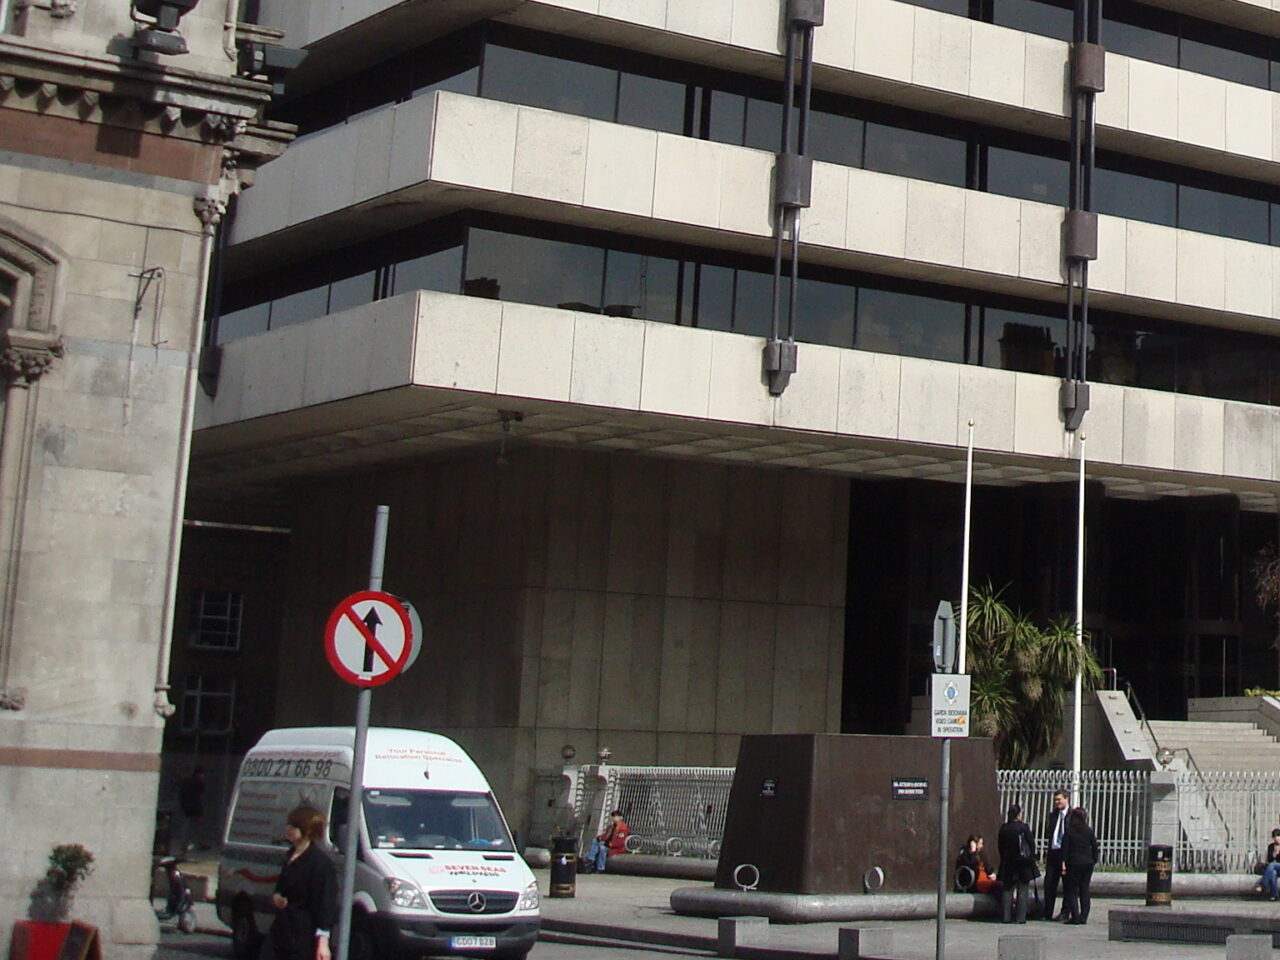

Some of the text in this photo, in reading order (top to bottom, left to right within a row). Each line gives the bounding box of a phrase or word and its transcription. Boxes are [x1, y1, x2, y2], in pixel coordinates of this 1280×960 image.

[243, 758, 333, 778] 0800 21 66 98
